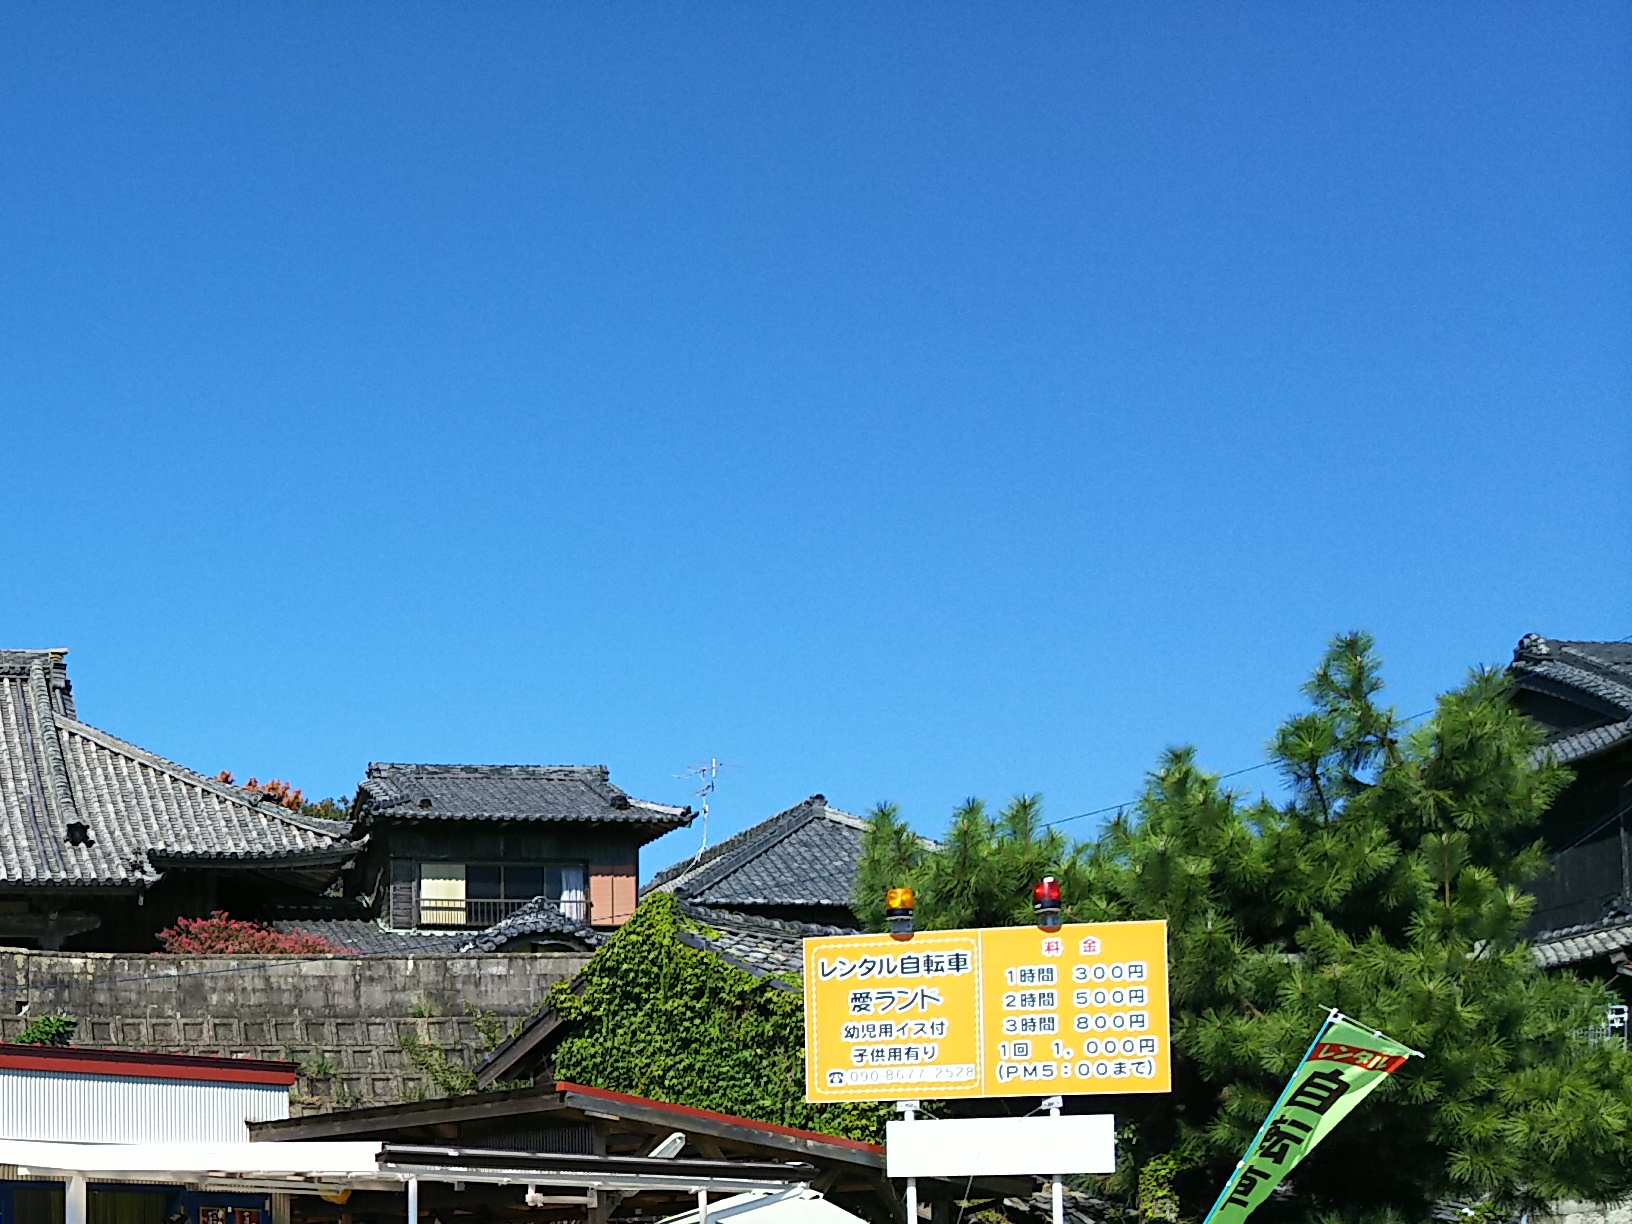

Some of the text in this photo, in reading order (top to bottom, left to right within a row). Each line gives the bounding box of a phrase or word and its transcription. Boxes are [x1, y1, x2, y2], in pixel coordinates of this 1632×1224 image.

[821, 953, 969, 978] レンタル自転車
[1007, 965, 1144, 984] 1時間 300円
[851, 989, 941, 1012] 愛ランド
[1005, 990, 1144, 1008] 2時間 500円
[844, 1021, 945, 1039] 幼児用イス付
[1006, 1014, 1144, 1032] 3時間 800円
[853, 1046, 936, 1063] 子供用有り
[1000, 1043, 1030, 1058] 1回
[1318, 1044, 1390, 1071] レンタル
